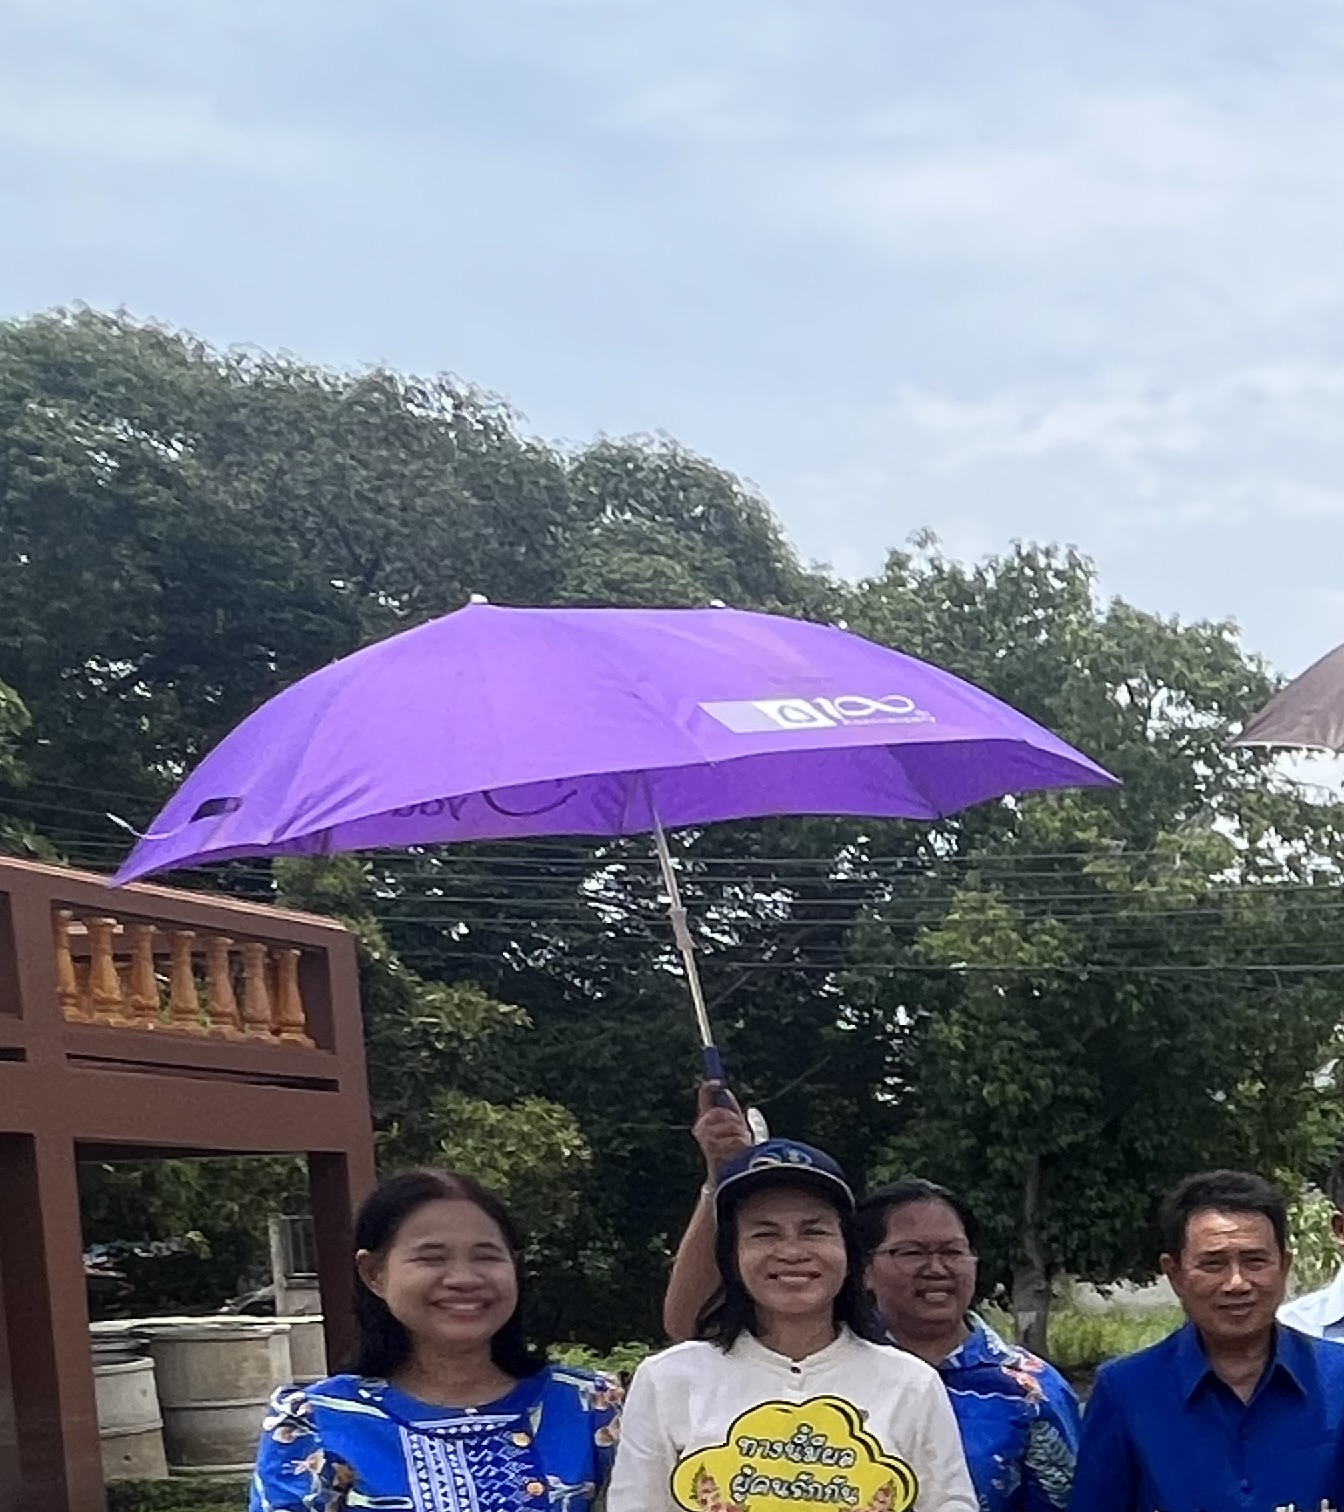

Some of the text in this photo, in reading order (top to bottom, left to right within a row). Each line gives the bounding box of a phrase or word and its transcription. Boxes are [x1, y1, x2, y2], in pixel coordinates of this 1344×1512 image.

[737, 1423, 856, 1467] ทางนี้มีผล
[730, 1464, 859, 1506] ผู้คนรักกัน
